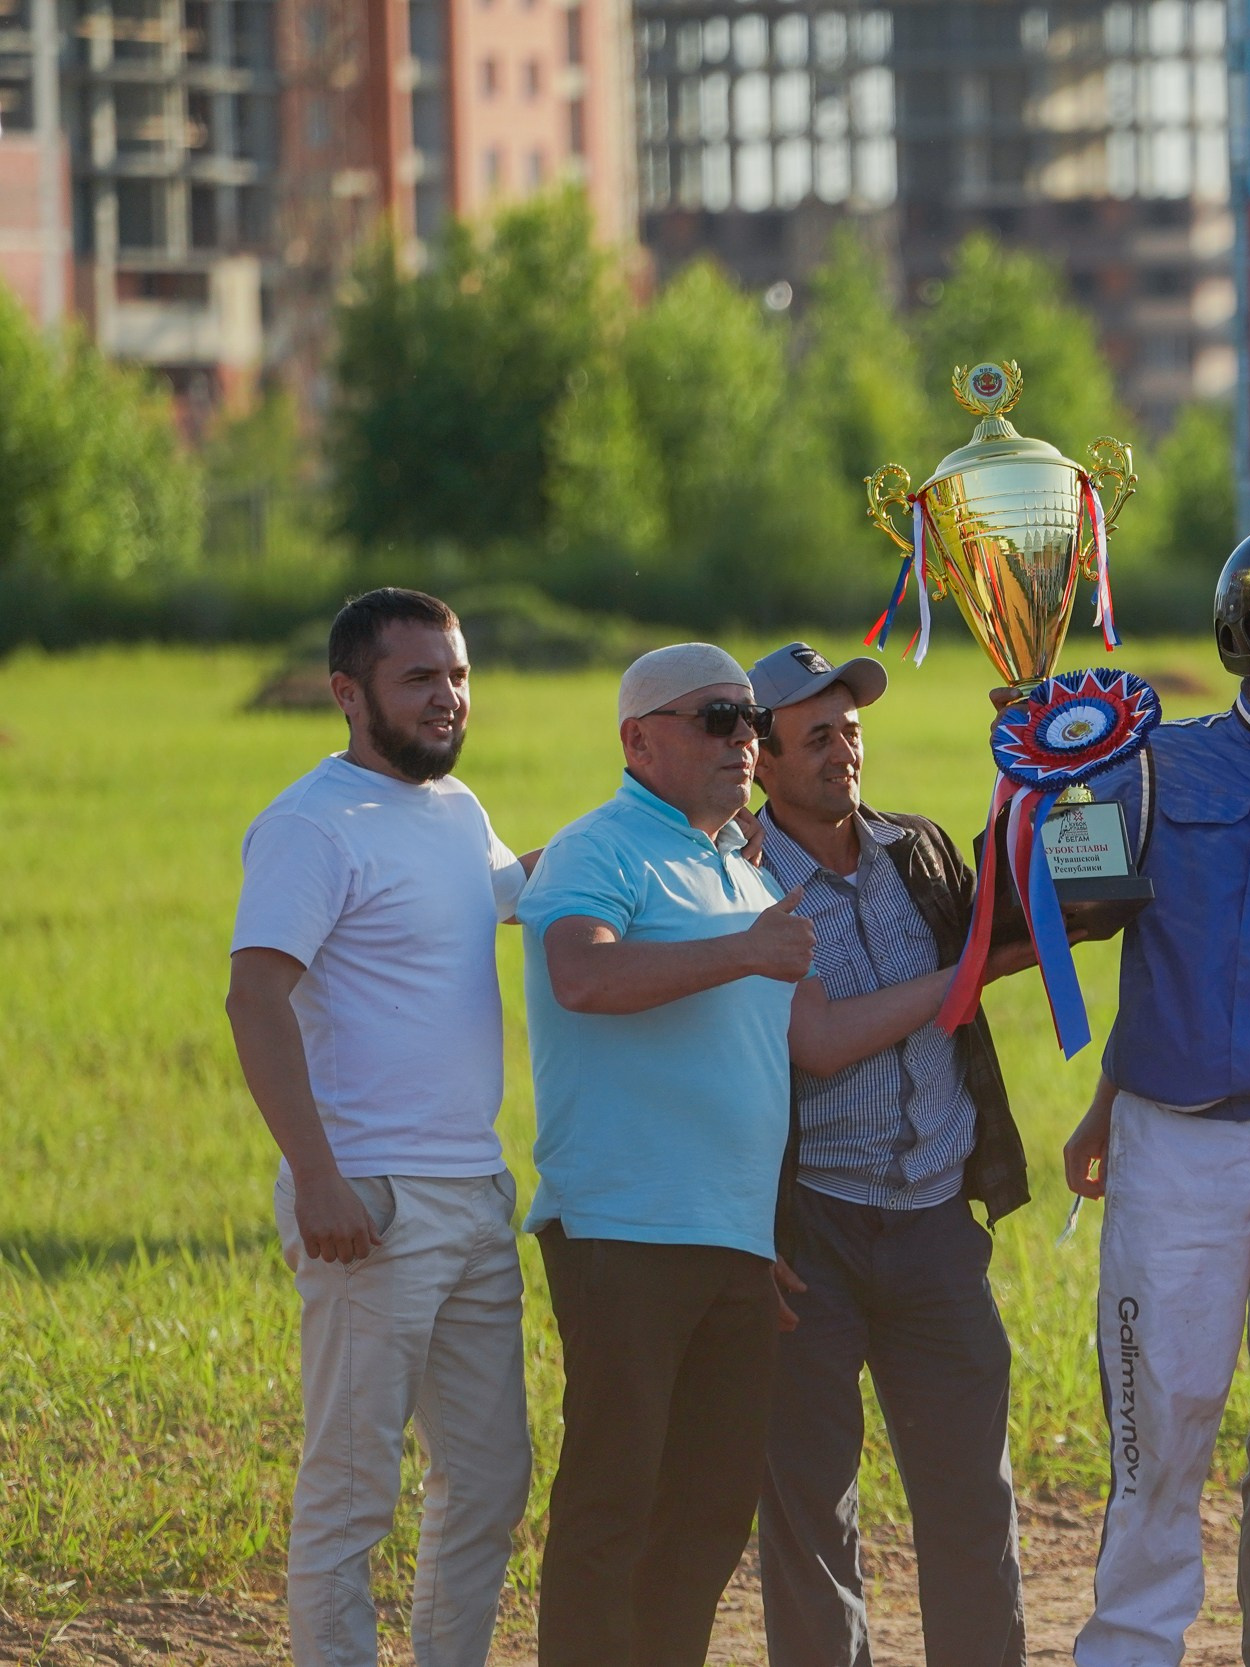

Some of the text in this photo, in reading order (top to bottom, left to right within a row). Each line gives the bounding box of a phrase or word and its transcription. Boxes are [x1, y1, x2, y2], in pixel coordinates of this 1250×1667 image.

[1076, 844, 1108, 853] ГЛАВЫ
[1053, 854, 1100, 865] Чувашской
[1054, 864, 1102, 874] Республики
[1117, 1296, 1140, 1481] Galimzynov
